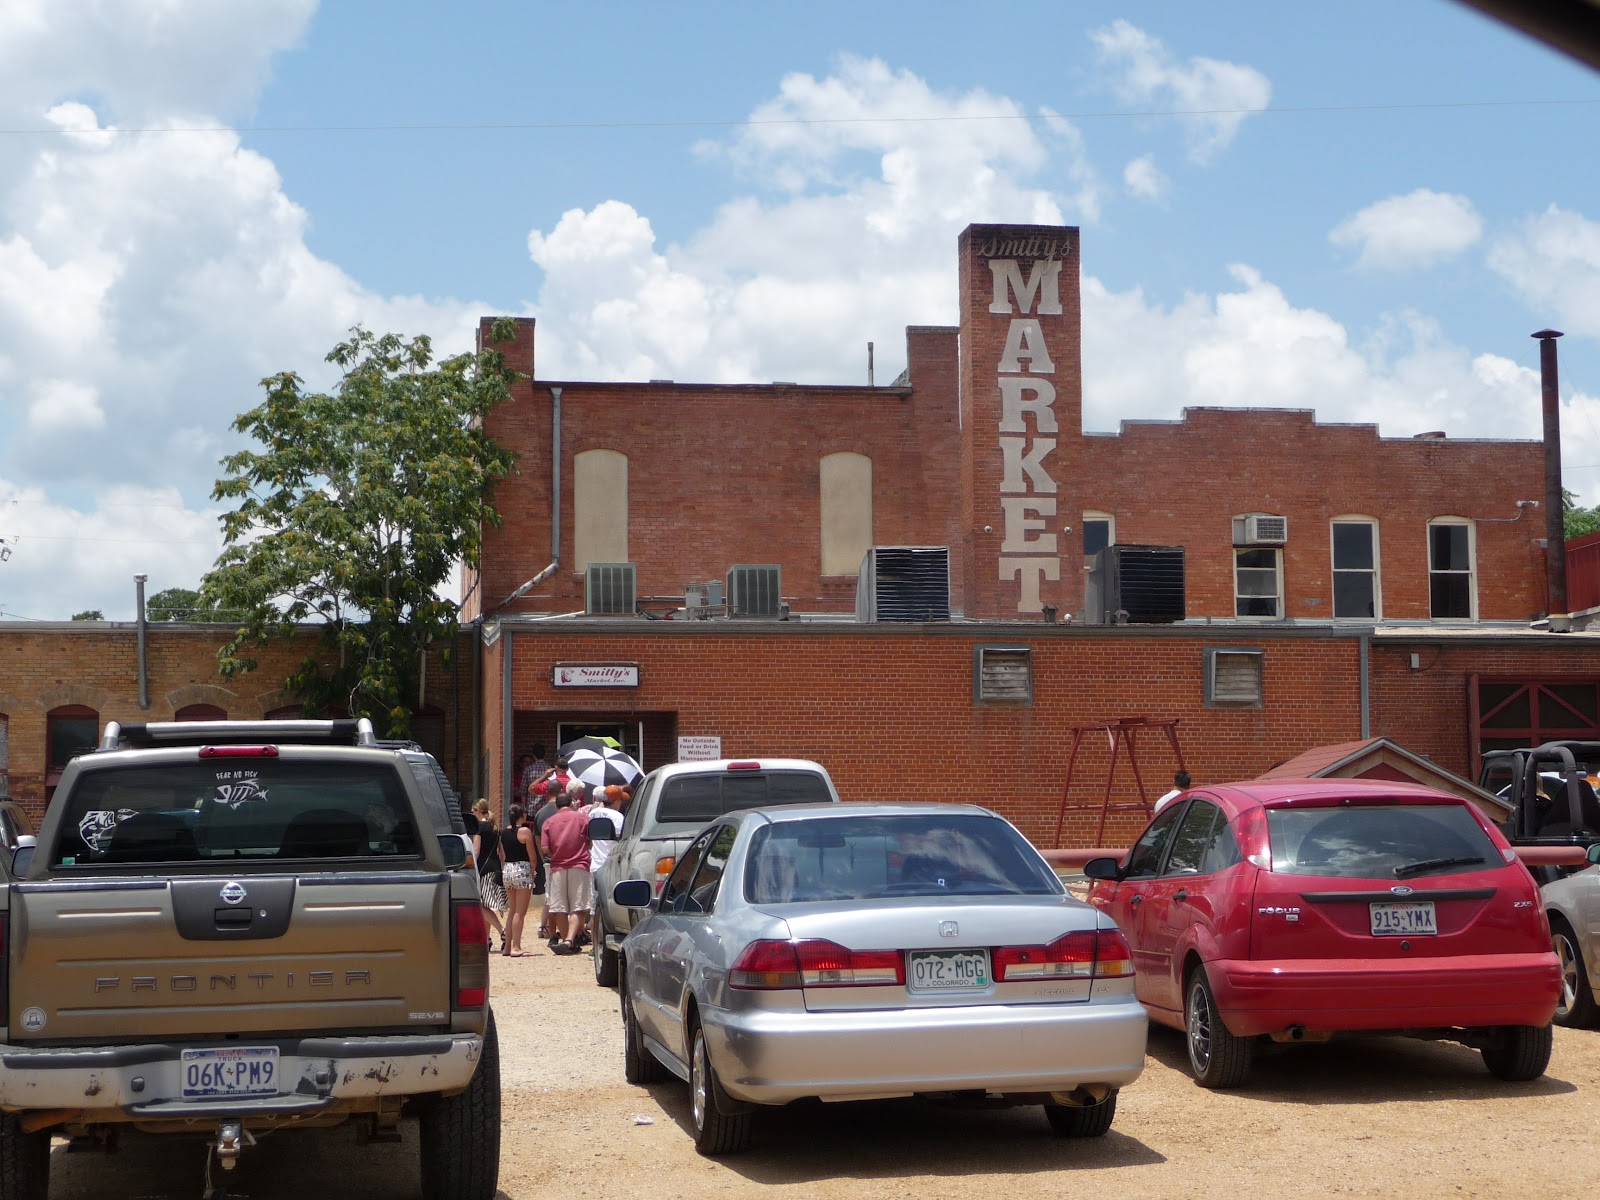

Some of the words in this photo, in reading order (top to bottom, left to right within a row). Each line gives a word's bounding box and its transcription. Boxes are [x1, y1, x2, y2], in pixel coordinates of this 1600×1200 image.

[977, 235, 1073, 275] Smitty's
[988, 259, 1064, 613] MARKET
[216, 772, 231, 780] FEAR
[245, 770, 258, 778] FISH
[1374, 911, 1400, 927] 915
[1406, 910, 1432, 926] YMX
[95, 970, 370, 993] FRONTIER
[216, 1049, 248, 1057] TEXAS
[187, 1063, 226, 1087] 06K
[236, 1061, 274, 1085] PM9
